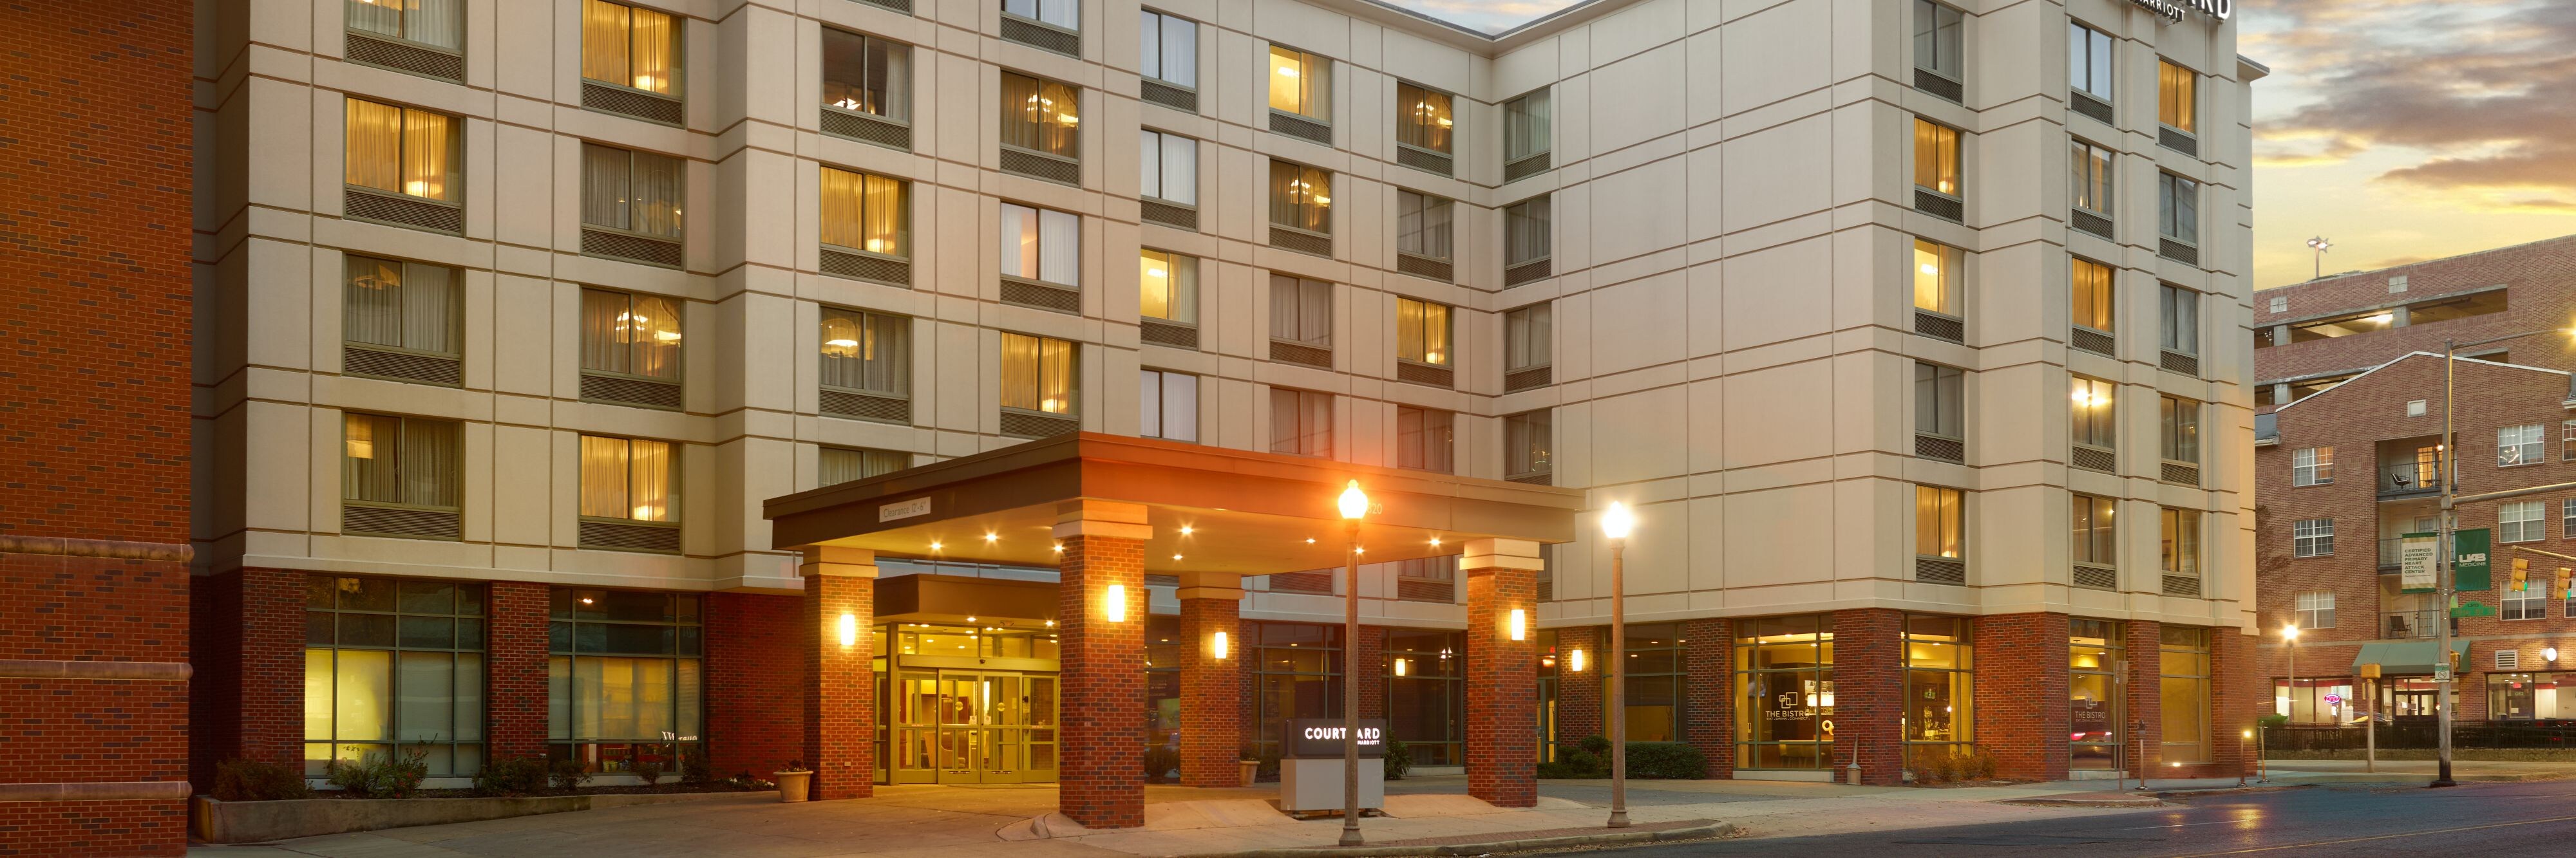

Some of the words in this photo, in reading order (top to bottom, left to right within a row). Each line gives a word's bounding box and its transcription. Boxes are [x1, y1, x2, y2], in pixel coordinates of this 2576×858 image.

[2139, 0, 2185, 21] RRIOTT
[884, 507, 910, 518] Clearance
[2459, 553, 2486, 563] UAB
[1305, 727, 1380, 740] COURTARD
